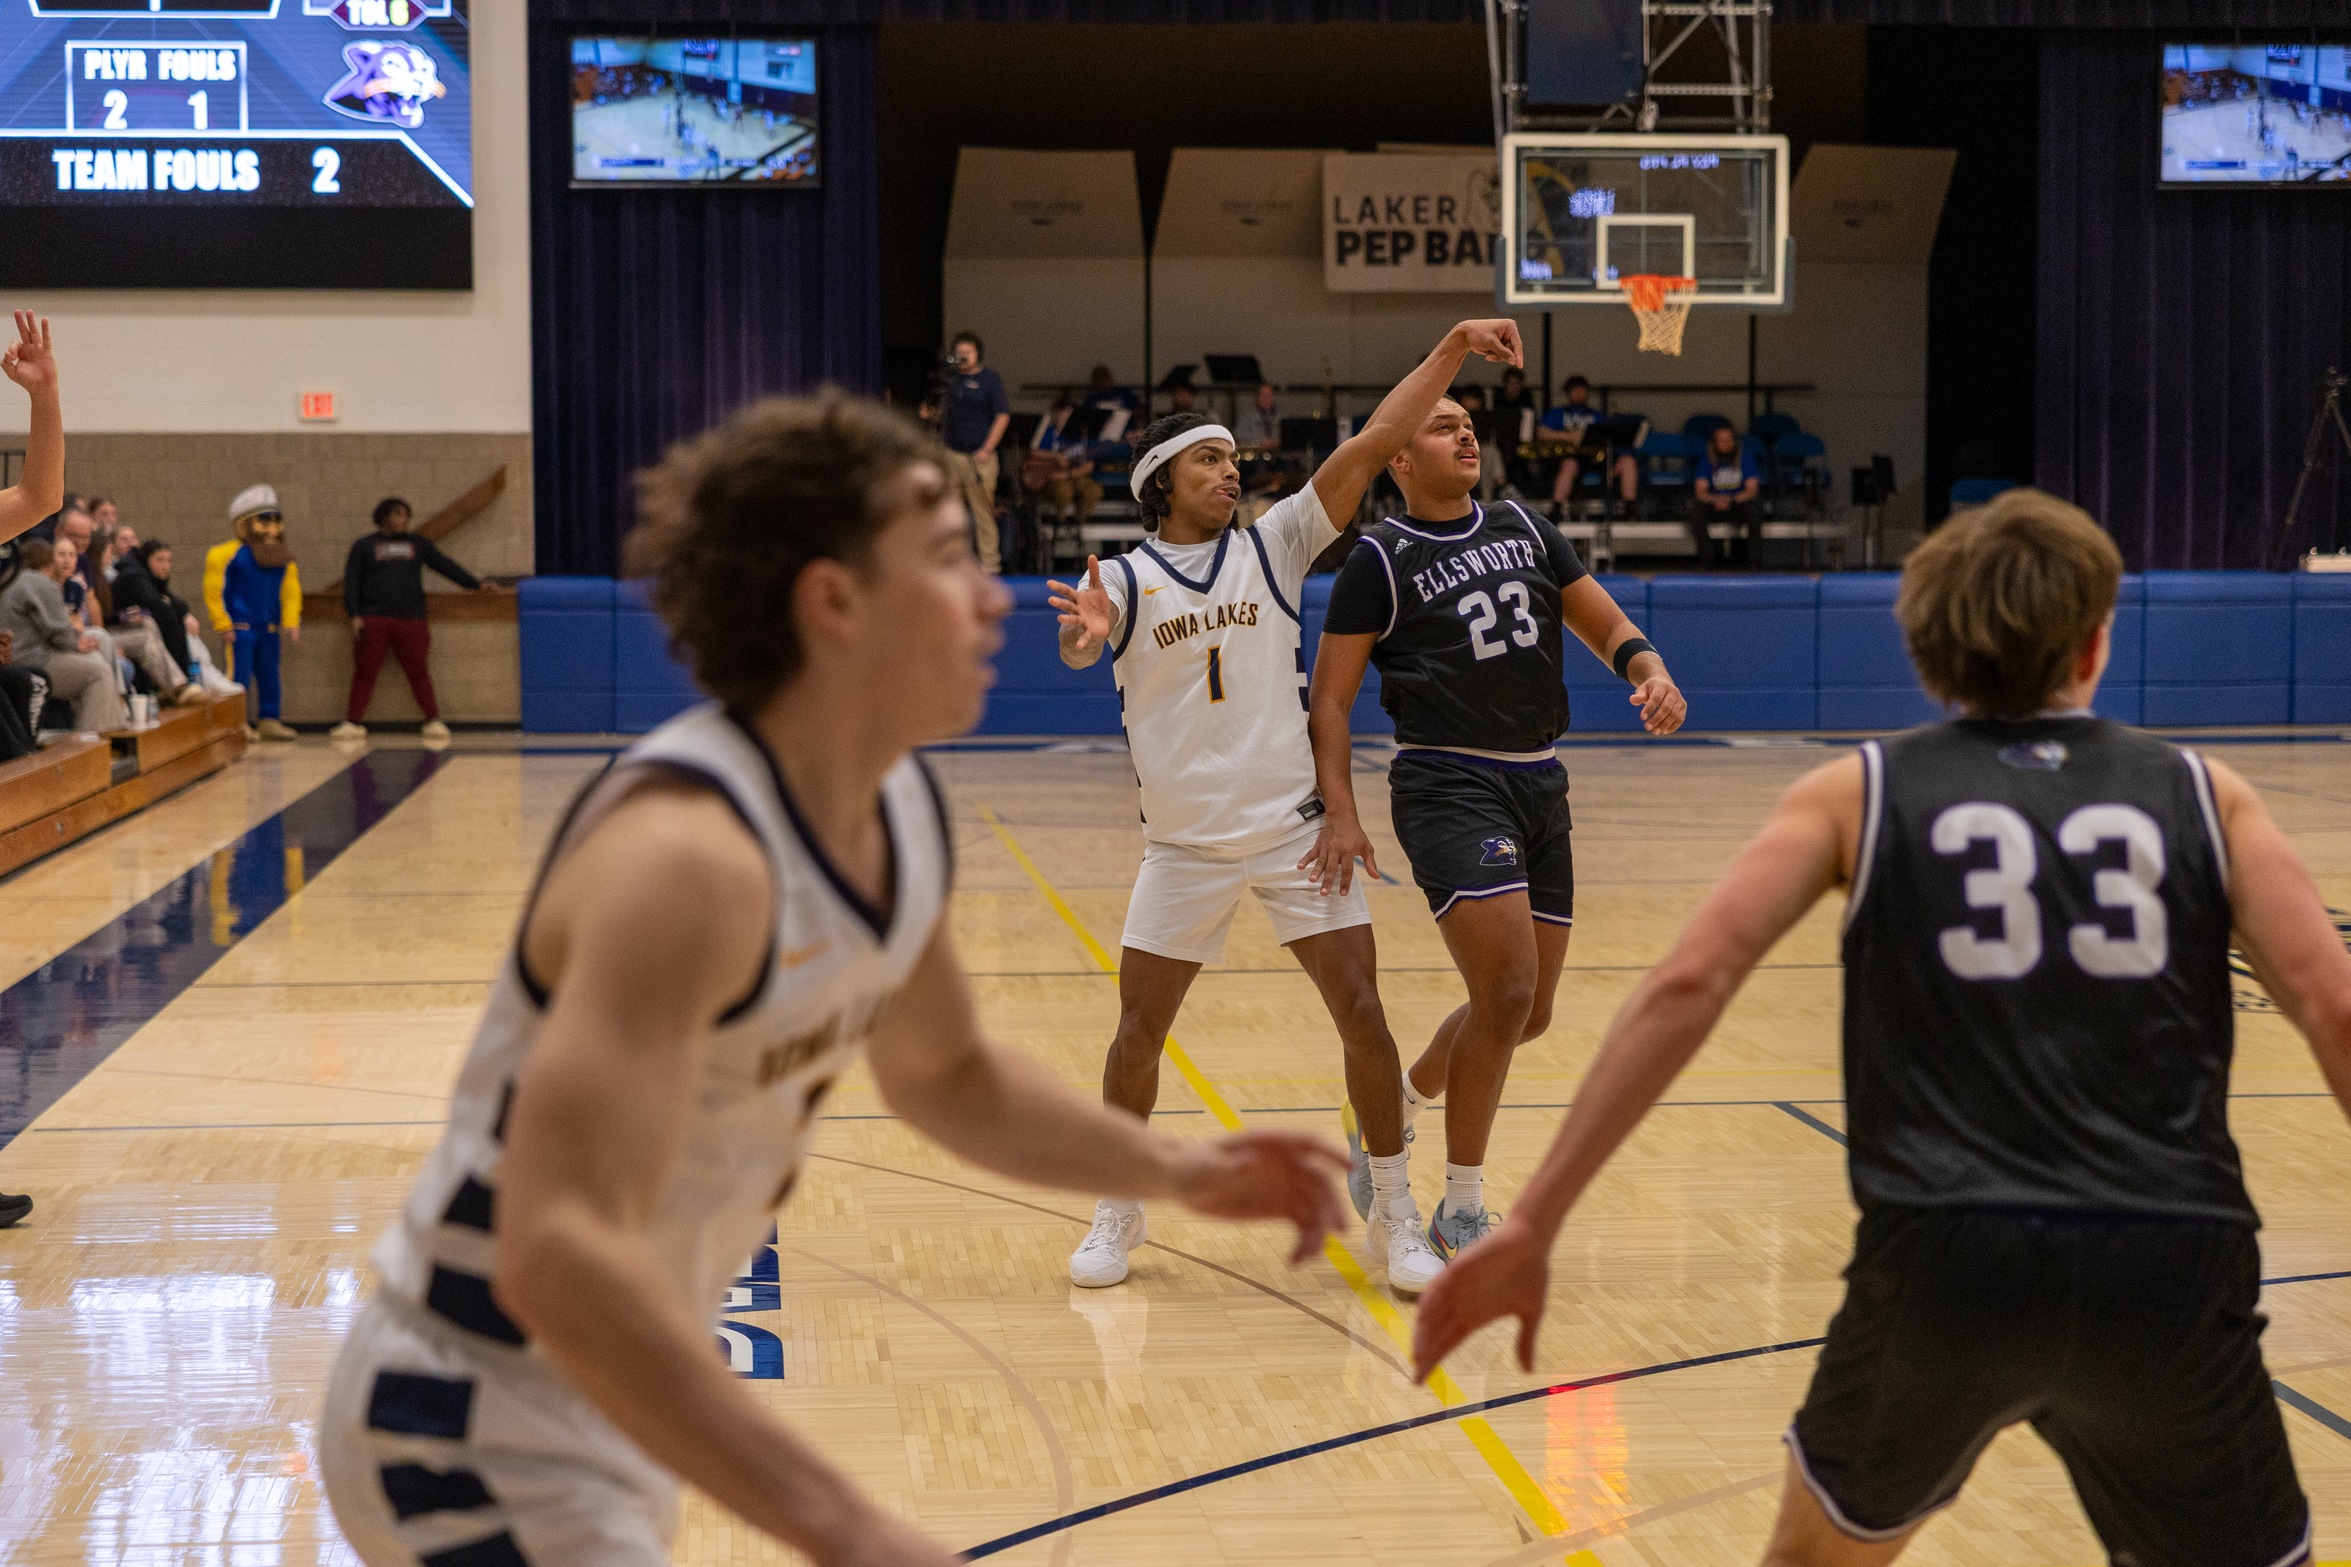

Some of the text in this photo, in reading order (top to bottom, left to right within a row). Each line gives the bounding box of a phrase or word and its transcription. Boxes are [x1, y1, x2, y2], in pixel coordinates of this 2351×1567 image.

[346, 0, 389, 25] TOL
[84, 49, 237, 81] PLYR FOULS
[103, 89, 208, 130] 2 1
[52, 147, 341, 194] TEAM FOULS 2
[1334, 196, 1456, 225] LAKER
[1336, 230, 1416, 266] PEP
[1412, 540, 1535, 603] ELLSWORTH
[1152, 601, 1259, 650] IOWA LAKES
[1457, 580, 1539, 661] 23
[1206, 645, 1226, 704] 1
[1930, 801, 2168, 981] 33
